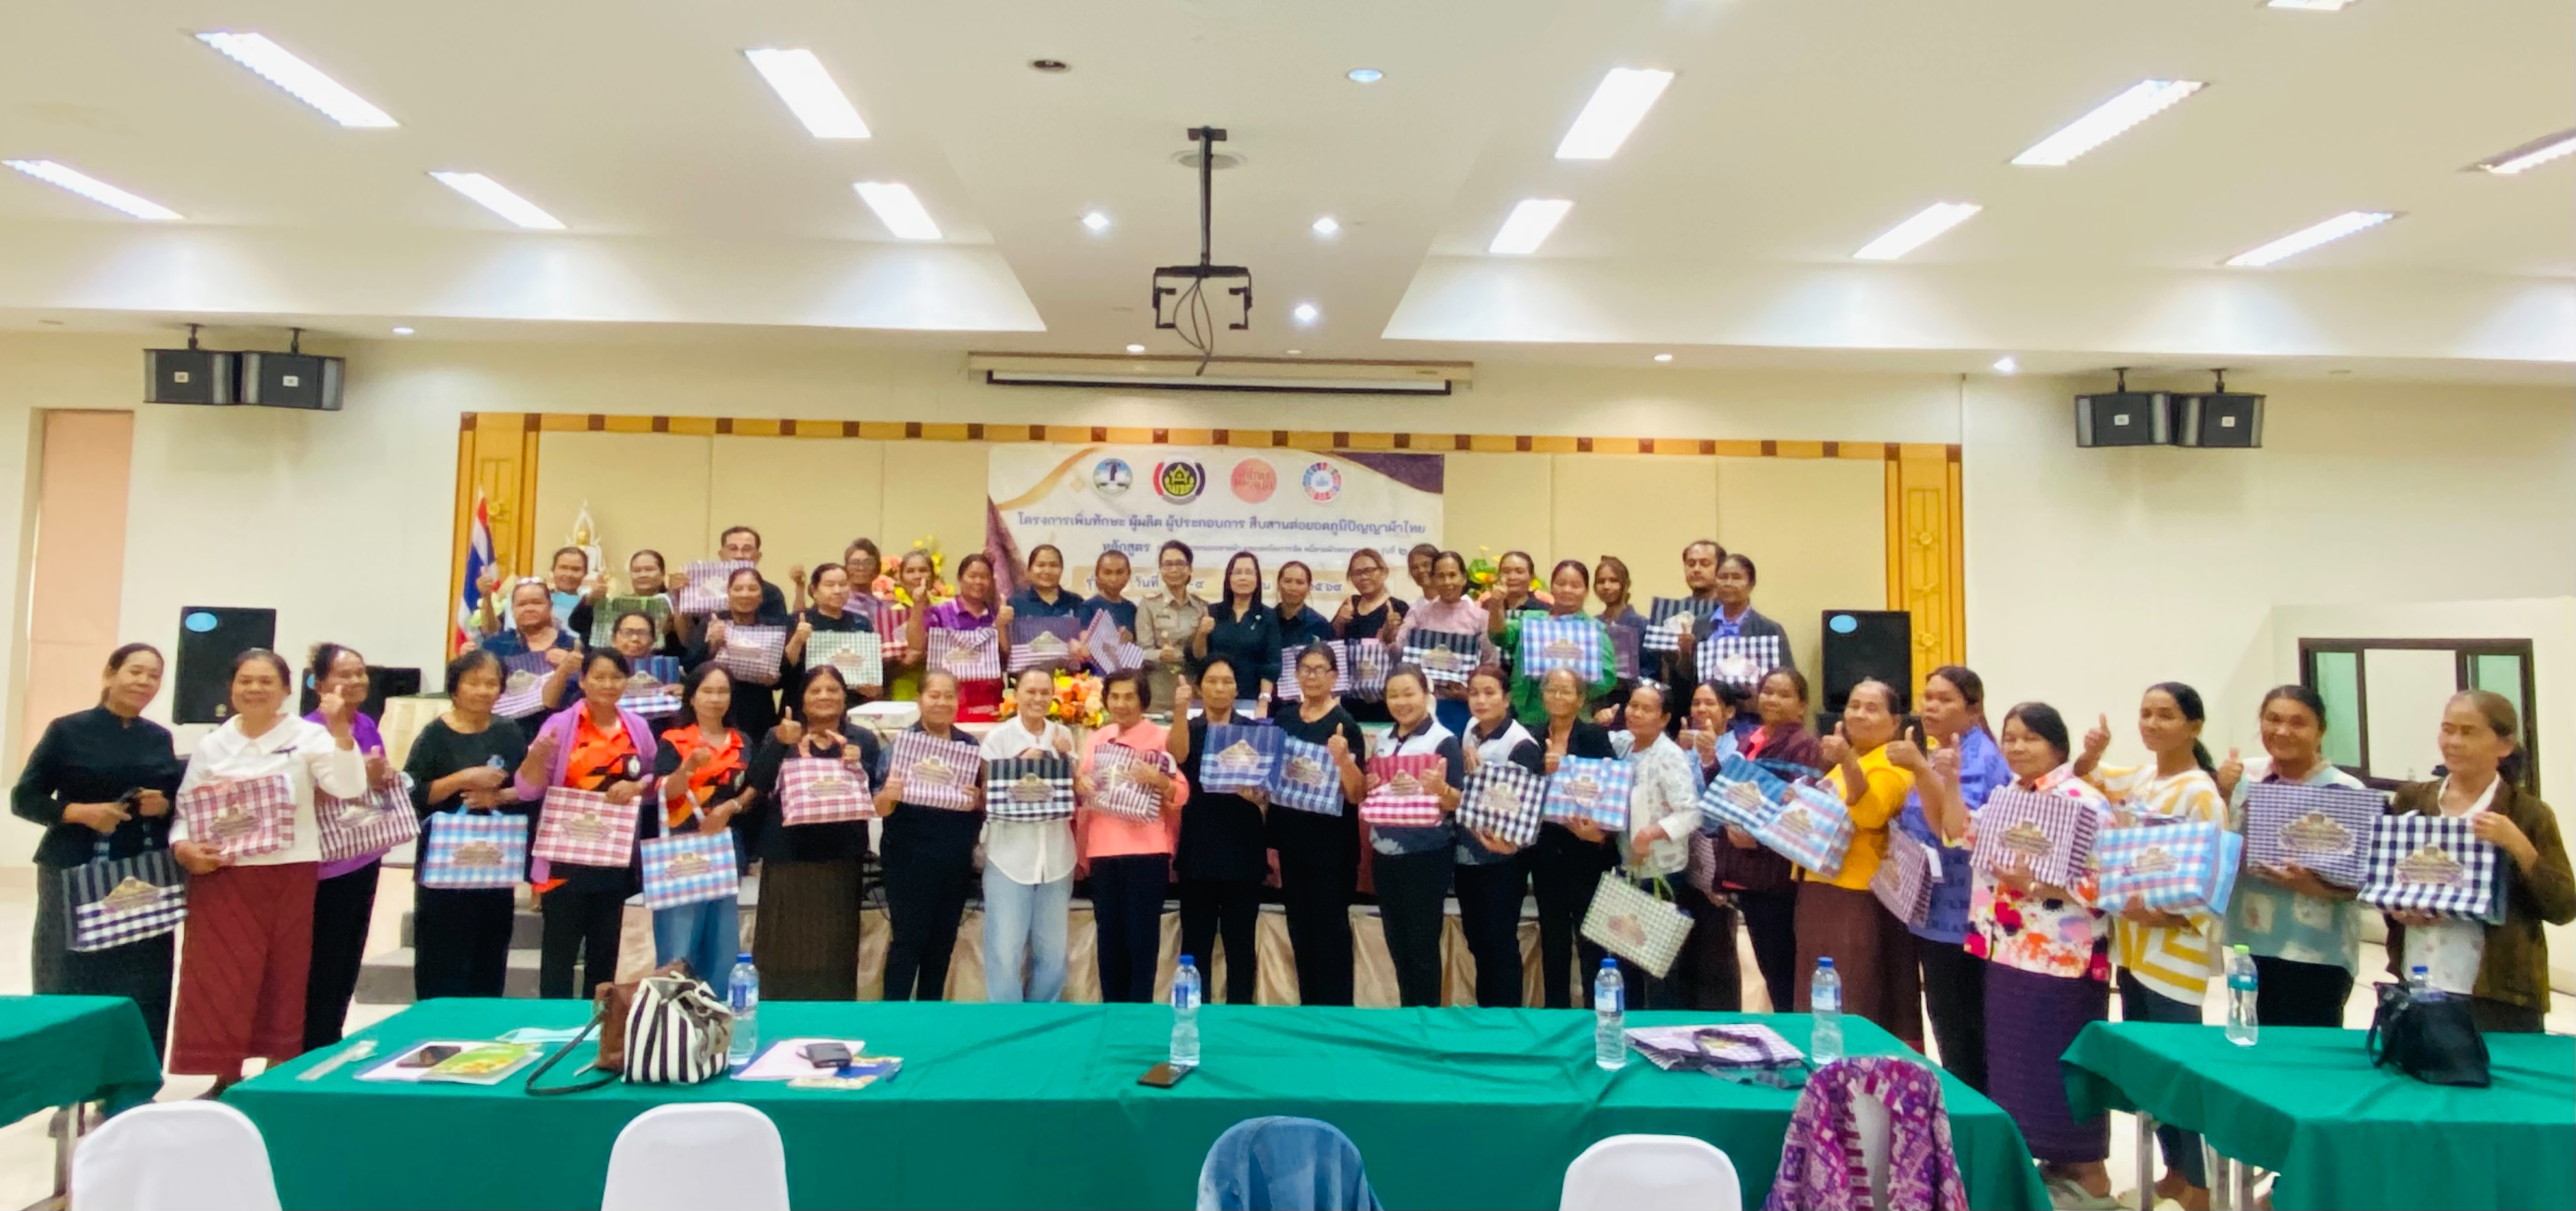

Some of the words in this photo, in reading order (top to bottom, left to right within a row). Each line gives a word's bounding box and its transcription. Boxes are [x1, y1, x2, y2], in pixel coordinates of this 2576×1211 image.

[1017, 509, 1125, 527] โครงการเพิ่มทักษะ
[1129, 514, 1162, 532] ผู้ผลิต
[1166, 514, 1246, 532] ผู้ประกอบการ
[1249, 515, 1426, 536] สืบสานต่อยอดภูมิปัญญาผ้าไทย
